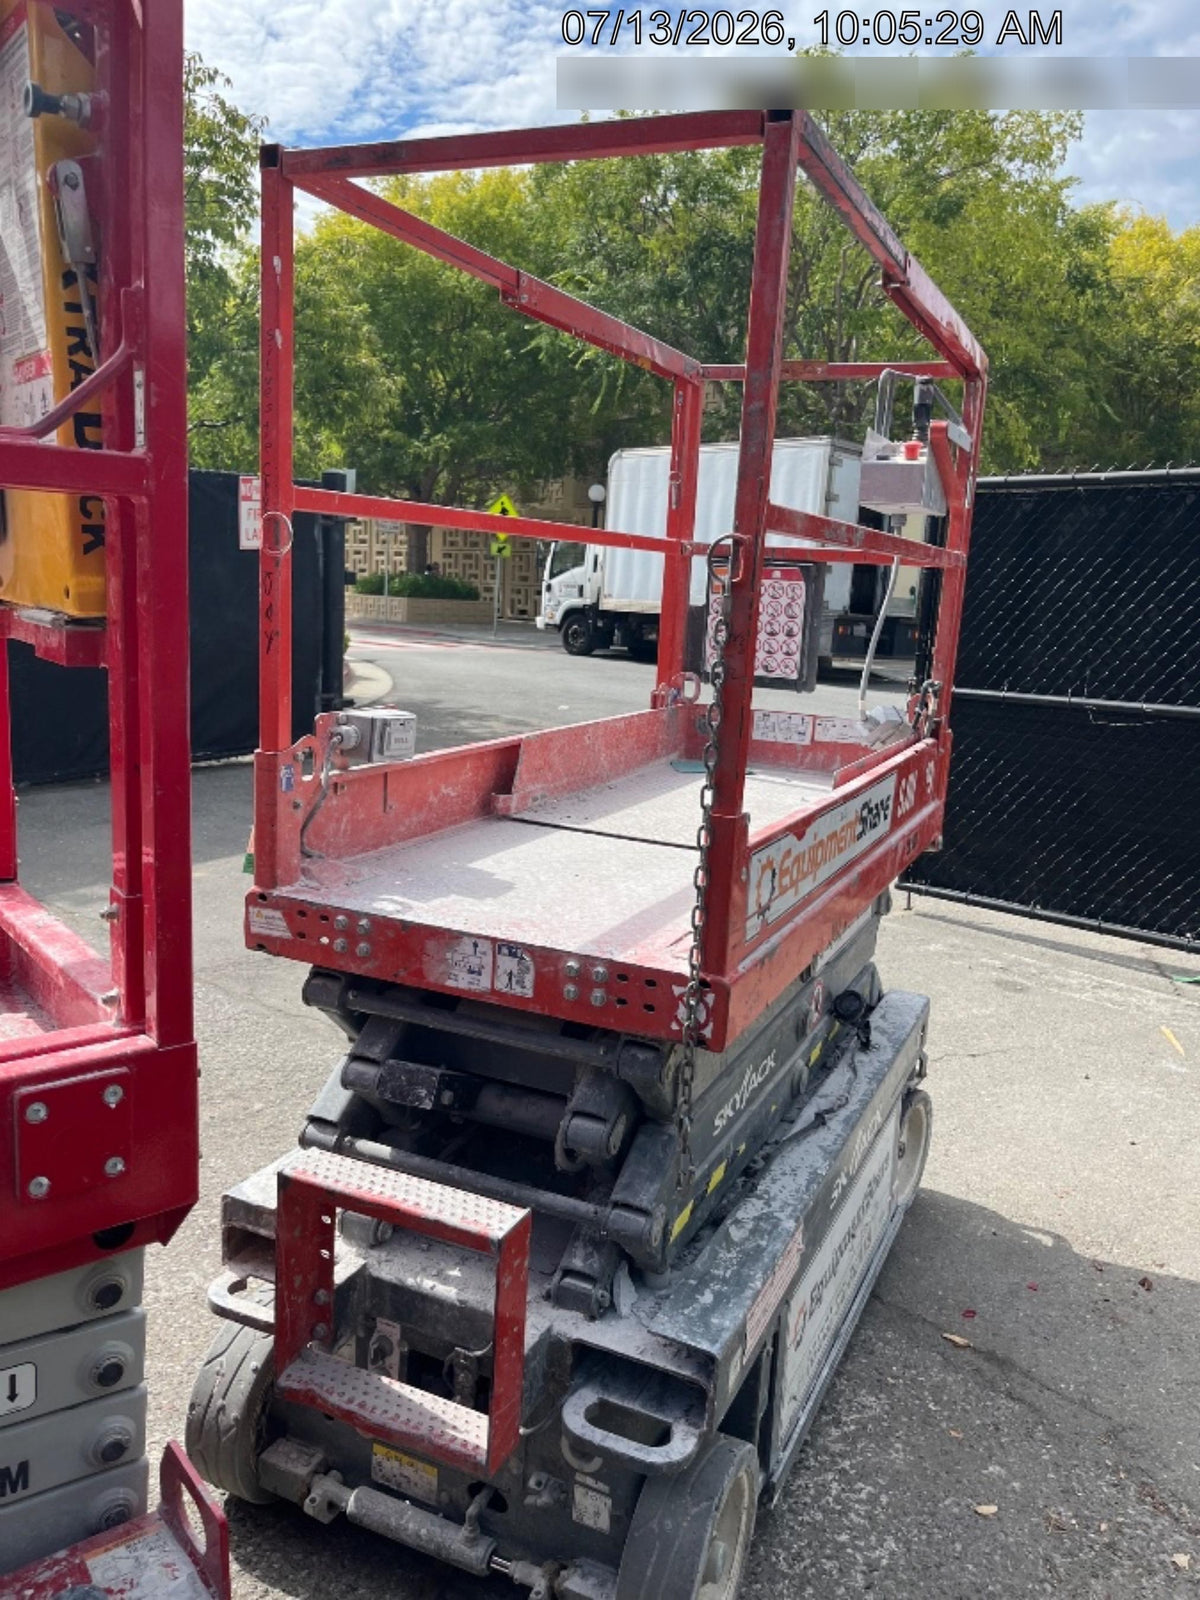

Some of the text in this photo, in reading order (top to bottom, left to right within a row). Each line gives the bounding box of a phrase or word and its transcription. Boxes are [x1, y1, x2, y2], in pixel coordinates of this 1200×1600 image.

[73, 412, 106, 555] DCK
[778, 794, 891, 897] EquipmentShare
[712, 1048, 777, 1137] SKYJACK
